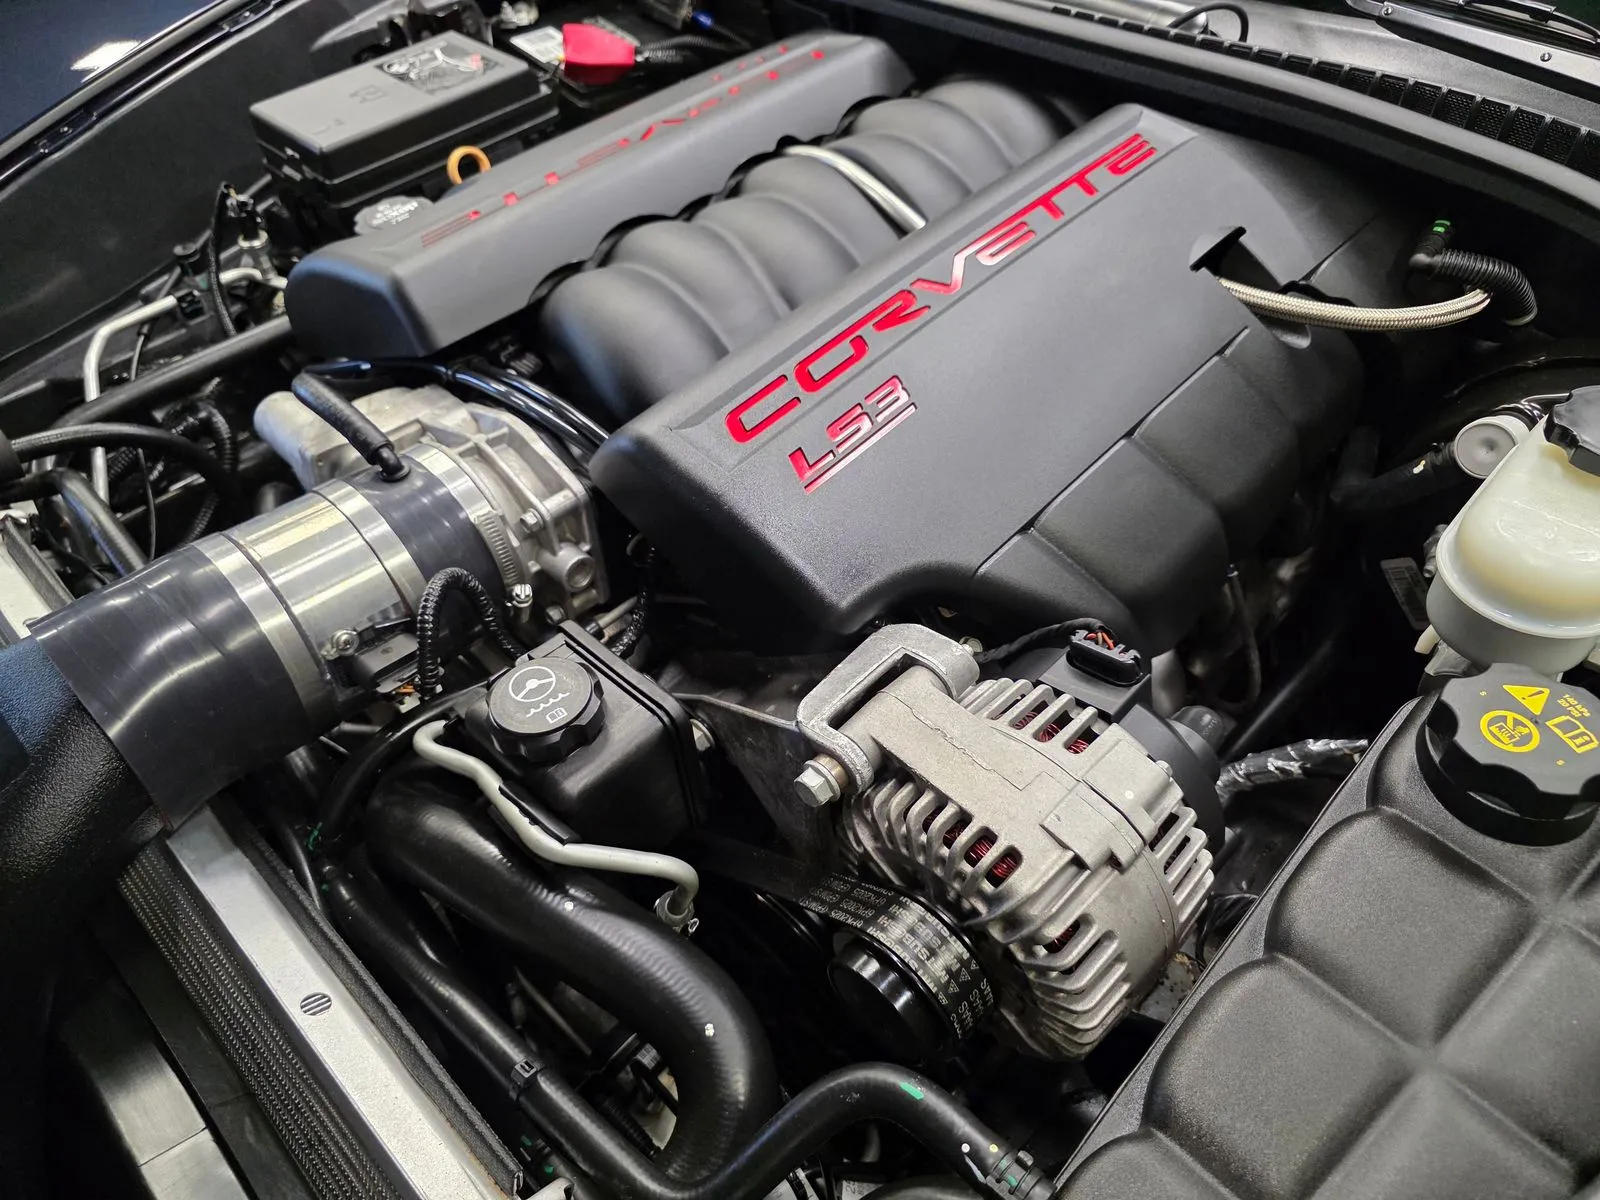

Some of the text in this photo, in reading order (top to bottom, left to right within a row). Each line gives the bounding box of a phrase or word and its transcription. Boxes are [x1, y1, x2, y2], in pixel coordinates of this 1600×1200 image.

[724, 133, 1158, 445] CORVETTE
[787, 374, 912, 484] LS3
[876, 914, 951, 985] MITSUBOSHI
